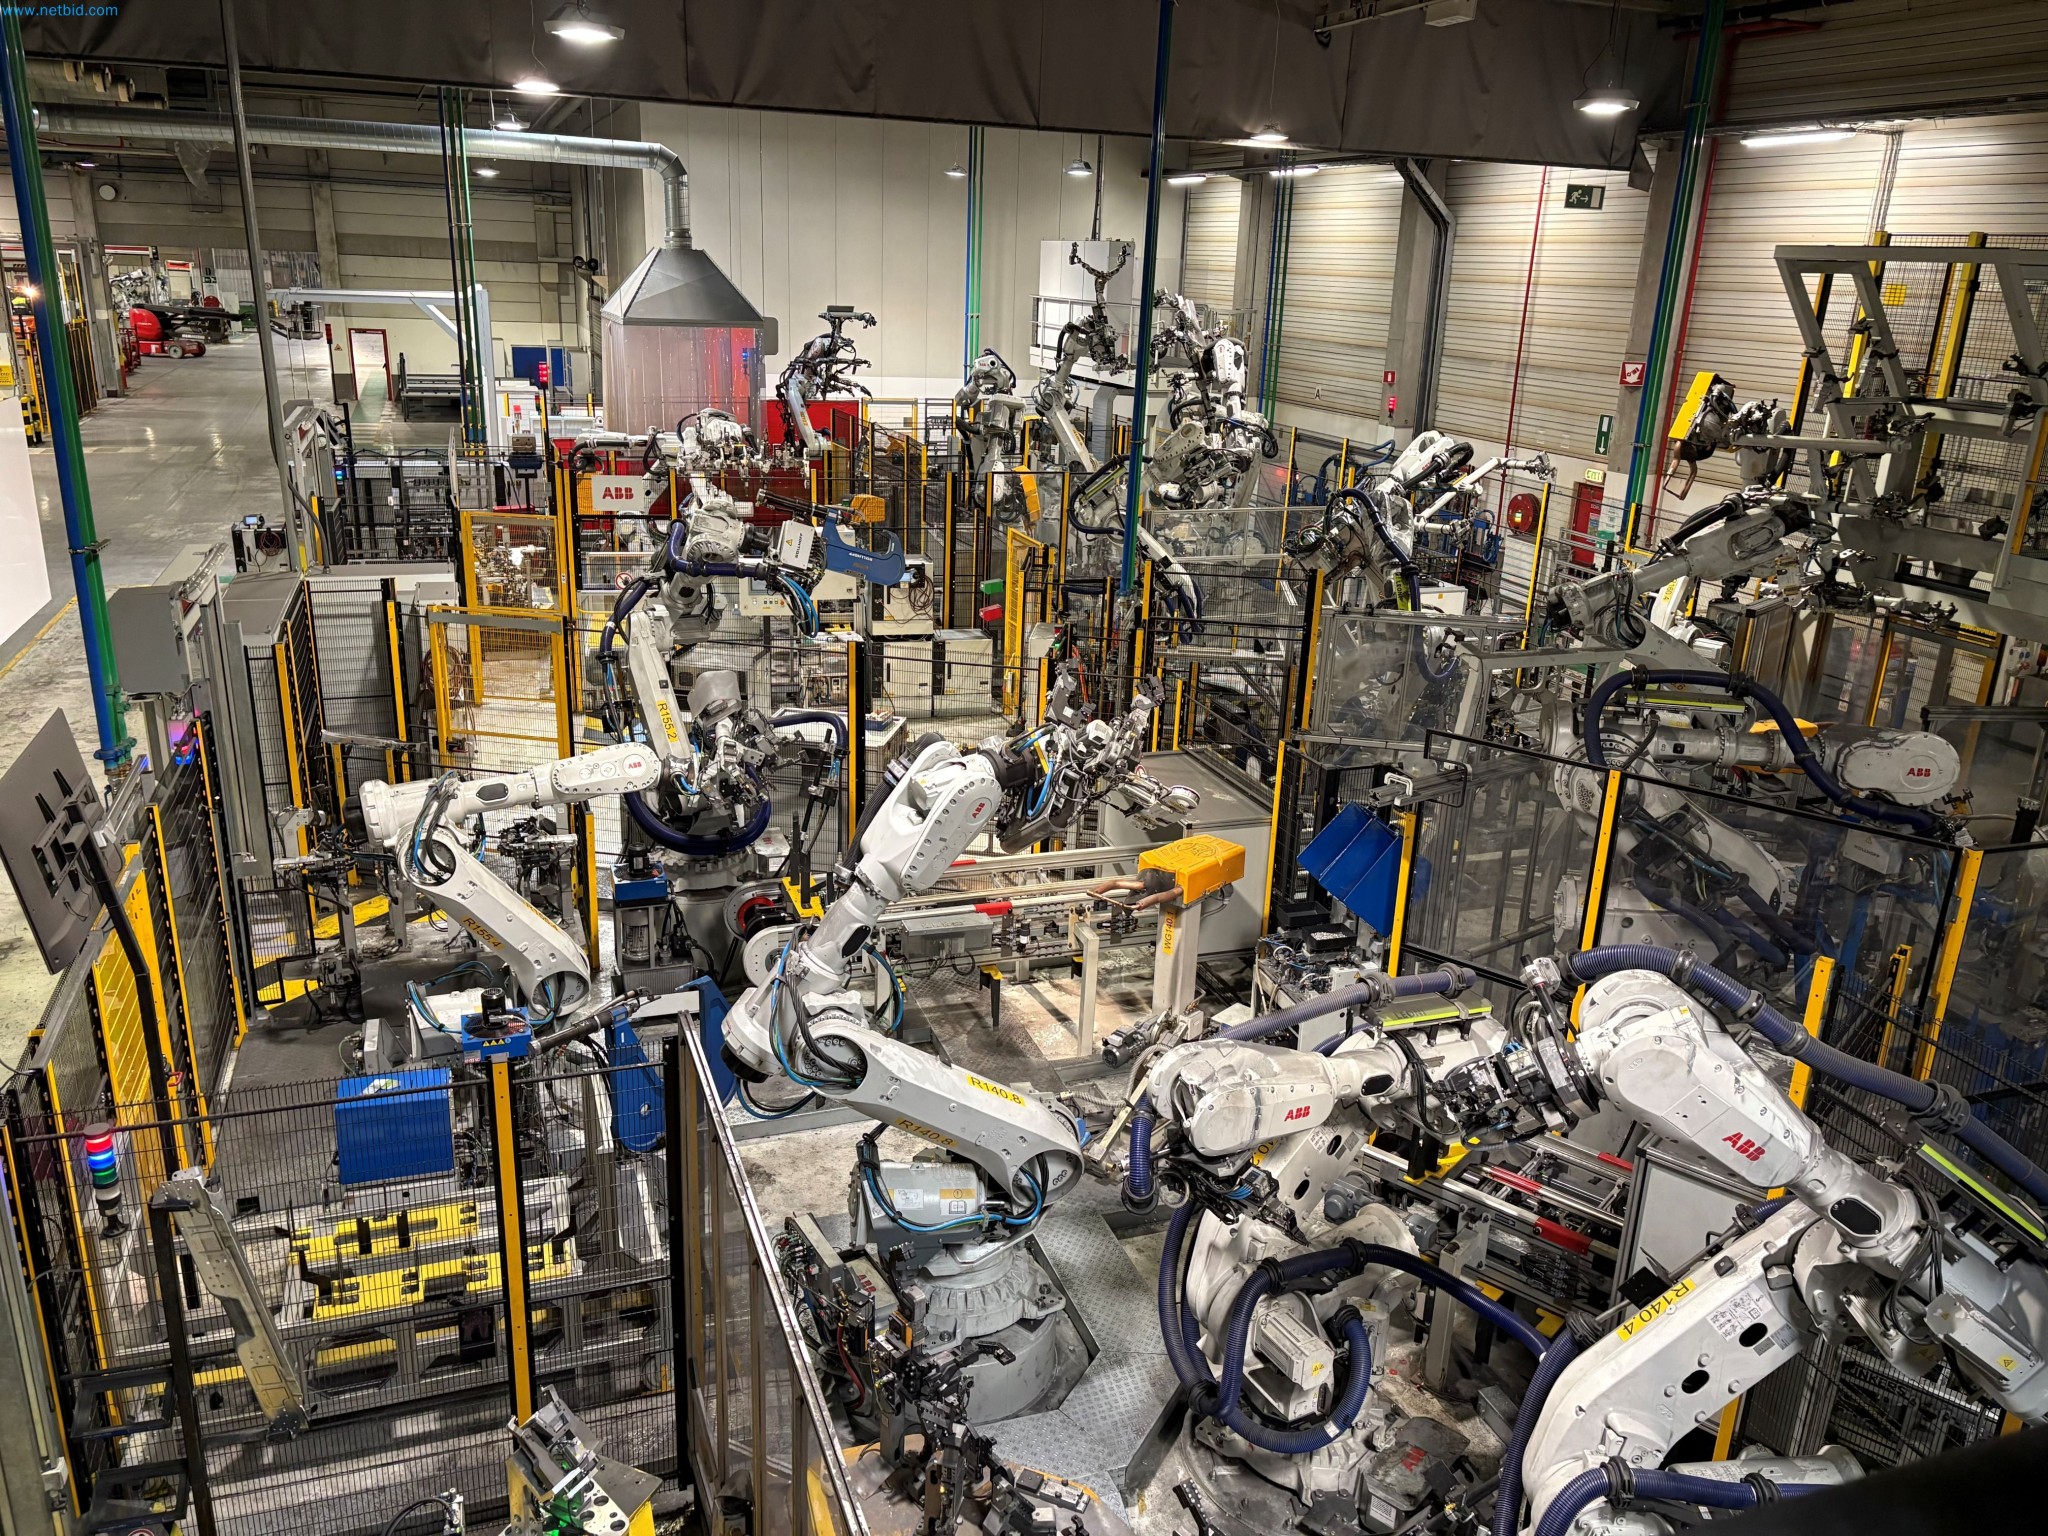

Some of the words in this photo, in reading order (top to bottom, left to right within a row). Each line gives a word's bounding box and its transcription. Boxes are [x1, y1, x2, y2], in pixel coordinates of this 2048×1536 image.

[602, 487, 634, 500] ABB
[658, 702, 677, 740] R155.2
[628, 761, 642, 770] ABB
[1906, 767, 1931, 777] ABB
[972, 802, 985, 819] ABB
[463, 917, 502, 948] R155.4
[1164, 911, 1175, 950] WG140.1
[970, 1076, 1021, 1104] R140.8
[1284, 1105, 1310, 1121] ABB
[898, 1119, 953, 1146] R140.8
[1722, 1132, 1766, 1162] ABB
[858, 1275, 876, 1293] ABB
[1623, 1282, 1690, 1335] R140.4
